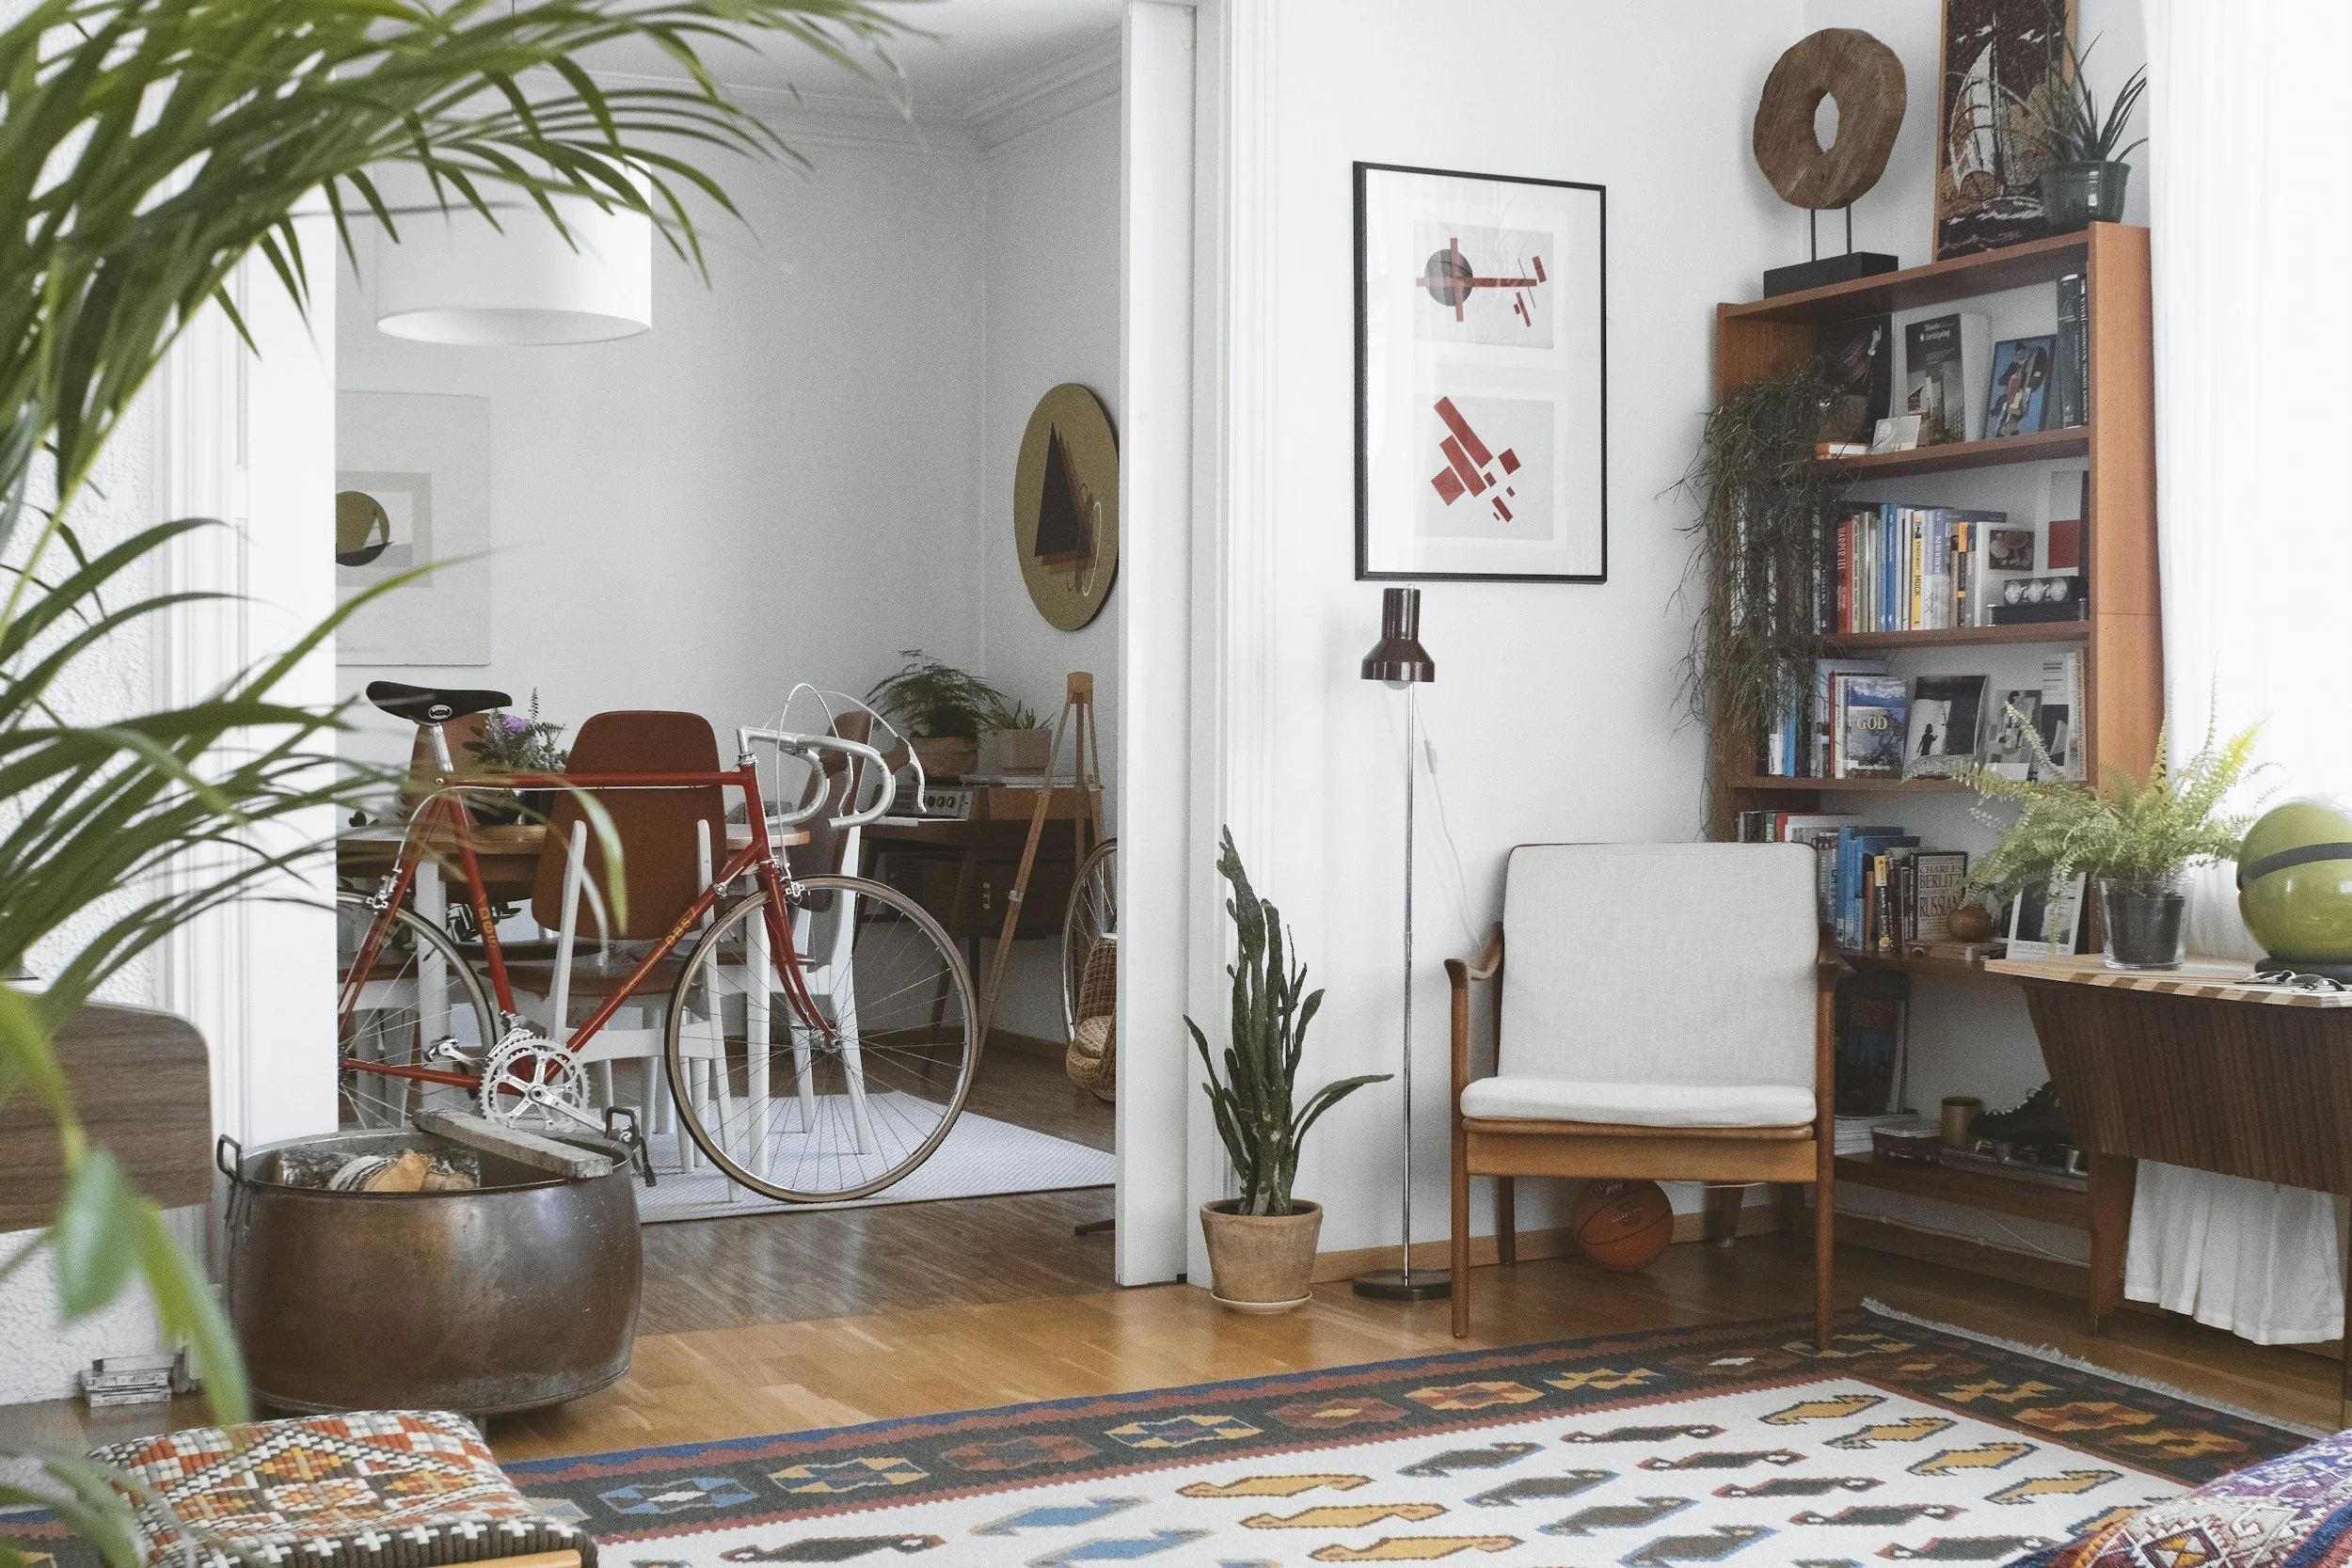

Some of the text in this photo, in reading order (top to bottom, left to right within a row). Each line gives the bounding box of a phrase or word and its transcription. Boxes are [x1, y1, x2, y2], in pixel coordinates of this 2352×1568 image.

[1837, 528, 1847, 570] HARPER LEE
[1856, 716, 1888, 730] GOD
[1920, 865, 1963, 874] CHARLES
[1920, 874, 1962, 888] BERLITZ
[478, 906, 497, 950] DBS
[664, 917, 691, 947] DBS
